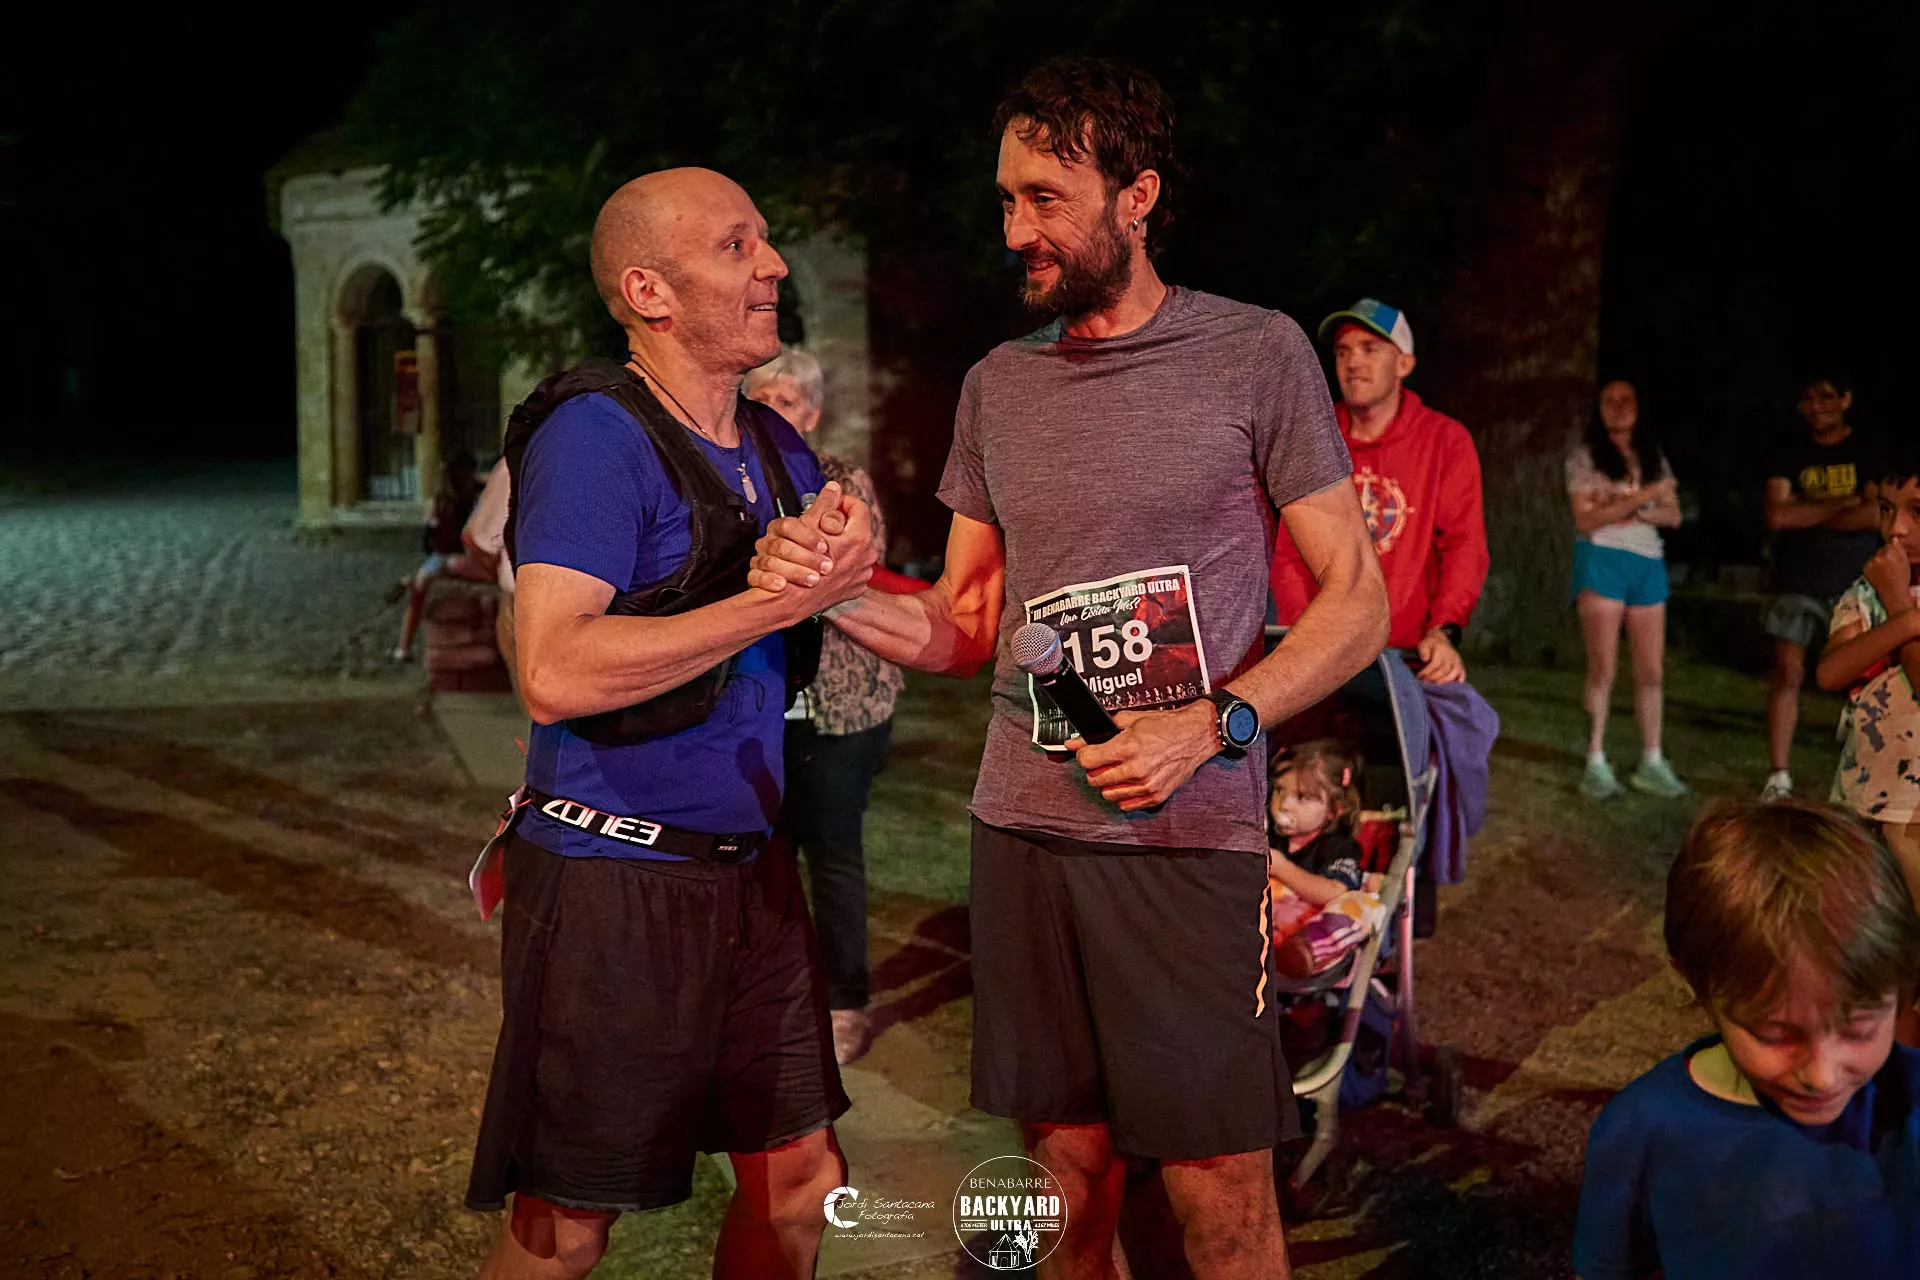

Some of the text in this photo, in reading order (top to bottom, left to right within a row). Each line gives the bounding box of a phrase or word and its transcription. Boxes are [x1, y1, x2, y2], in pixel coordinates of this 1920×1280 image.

[1033, 578, 1180, 621] III BENABARRE BACKYARD ULTRA
[1060, 612, 1078, 626] Una
[1063, 619, 1153, 674] 158
[1083, 668, 1143, 695] Miguel
[541, 799, 662, 846] ZONE3
